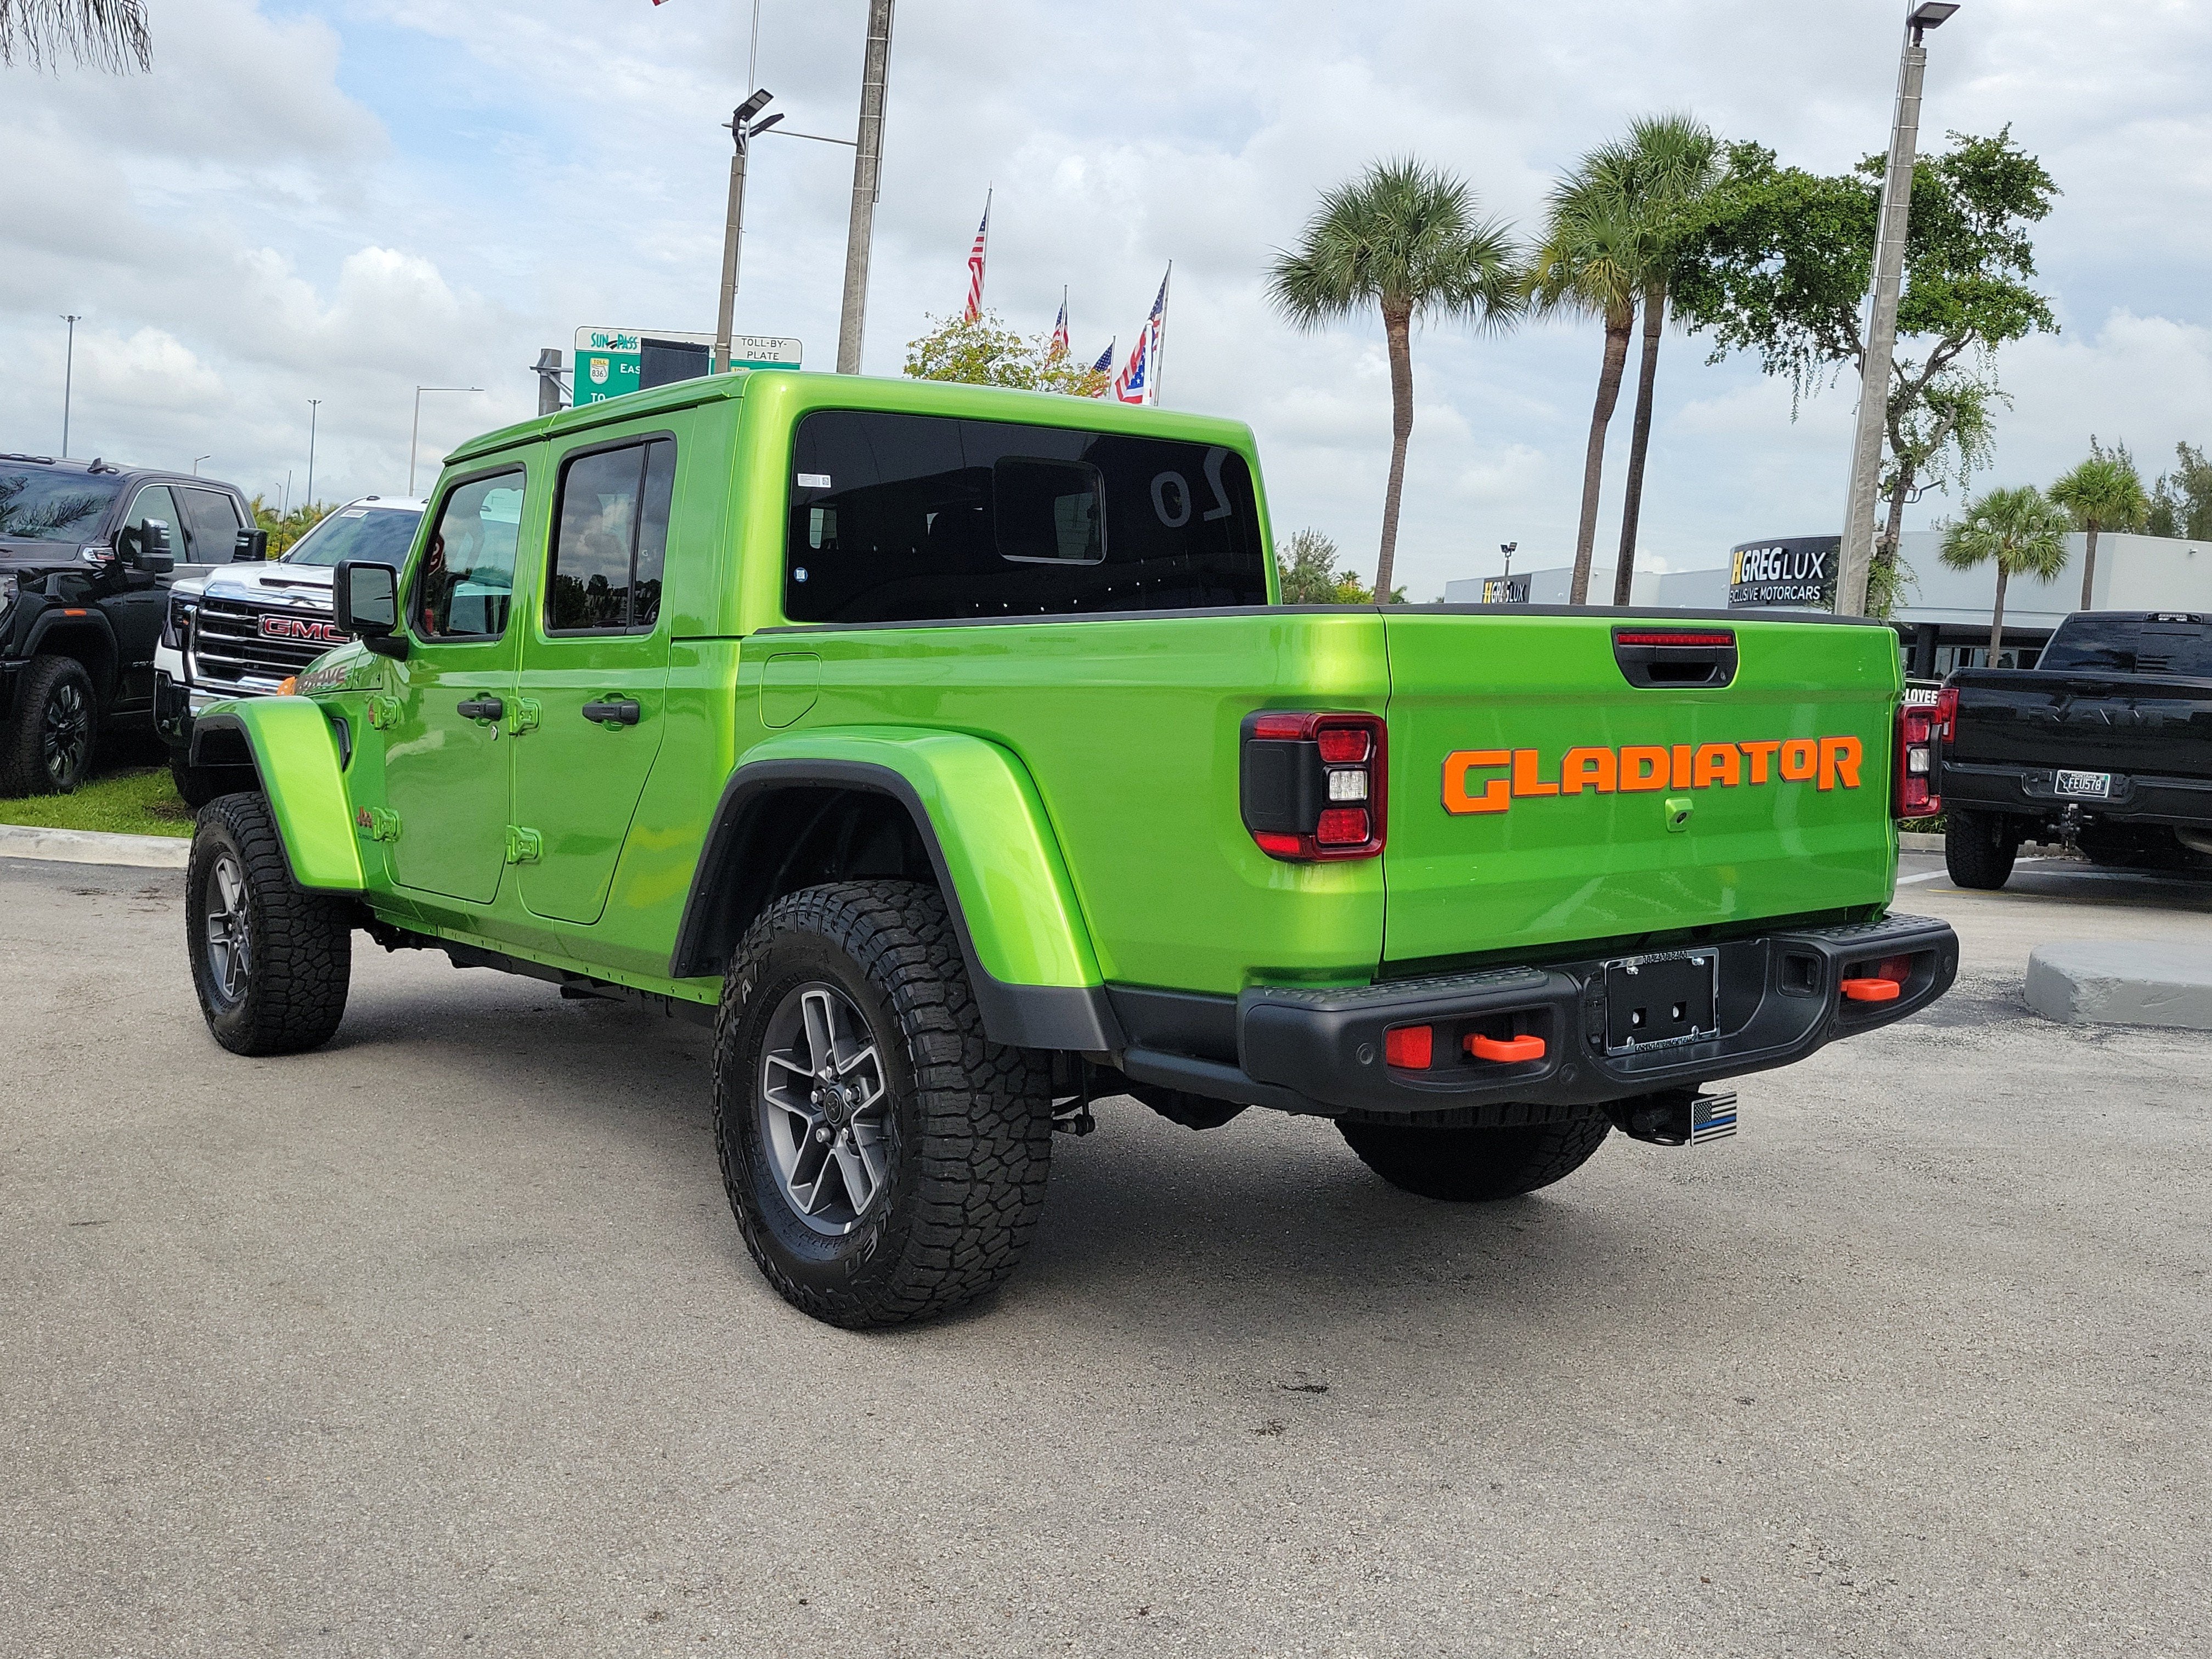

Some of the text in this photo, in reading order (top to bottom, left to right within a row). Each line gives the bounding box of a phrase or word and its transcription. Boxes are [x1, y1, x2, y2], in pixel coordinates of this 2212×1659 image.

[741, 338, 787, 348] TOLL-BY-
[747, 351, 779, 360] PLATE
[620, 363, 640, 374] EAS
[1730, 586, 1821, 602] EXCLUSIVE MOTORCARS
[265, 618, 350, 642] GMC
[1903, 688, 1938, 704] LOYEE
[1441, 736, 1863, 816] GLADIATOR
[2068, 777, 2101, 790] FEU578
